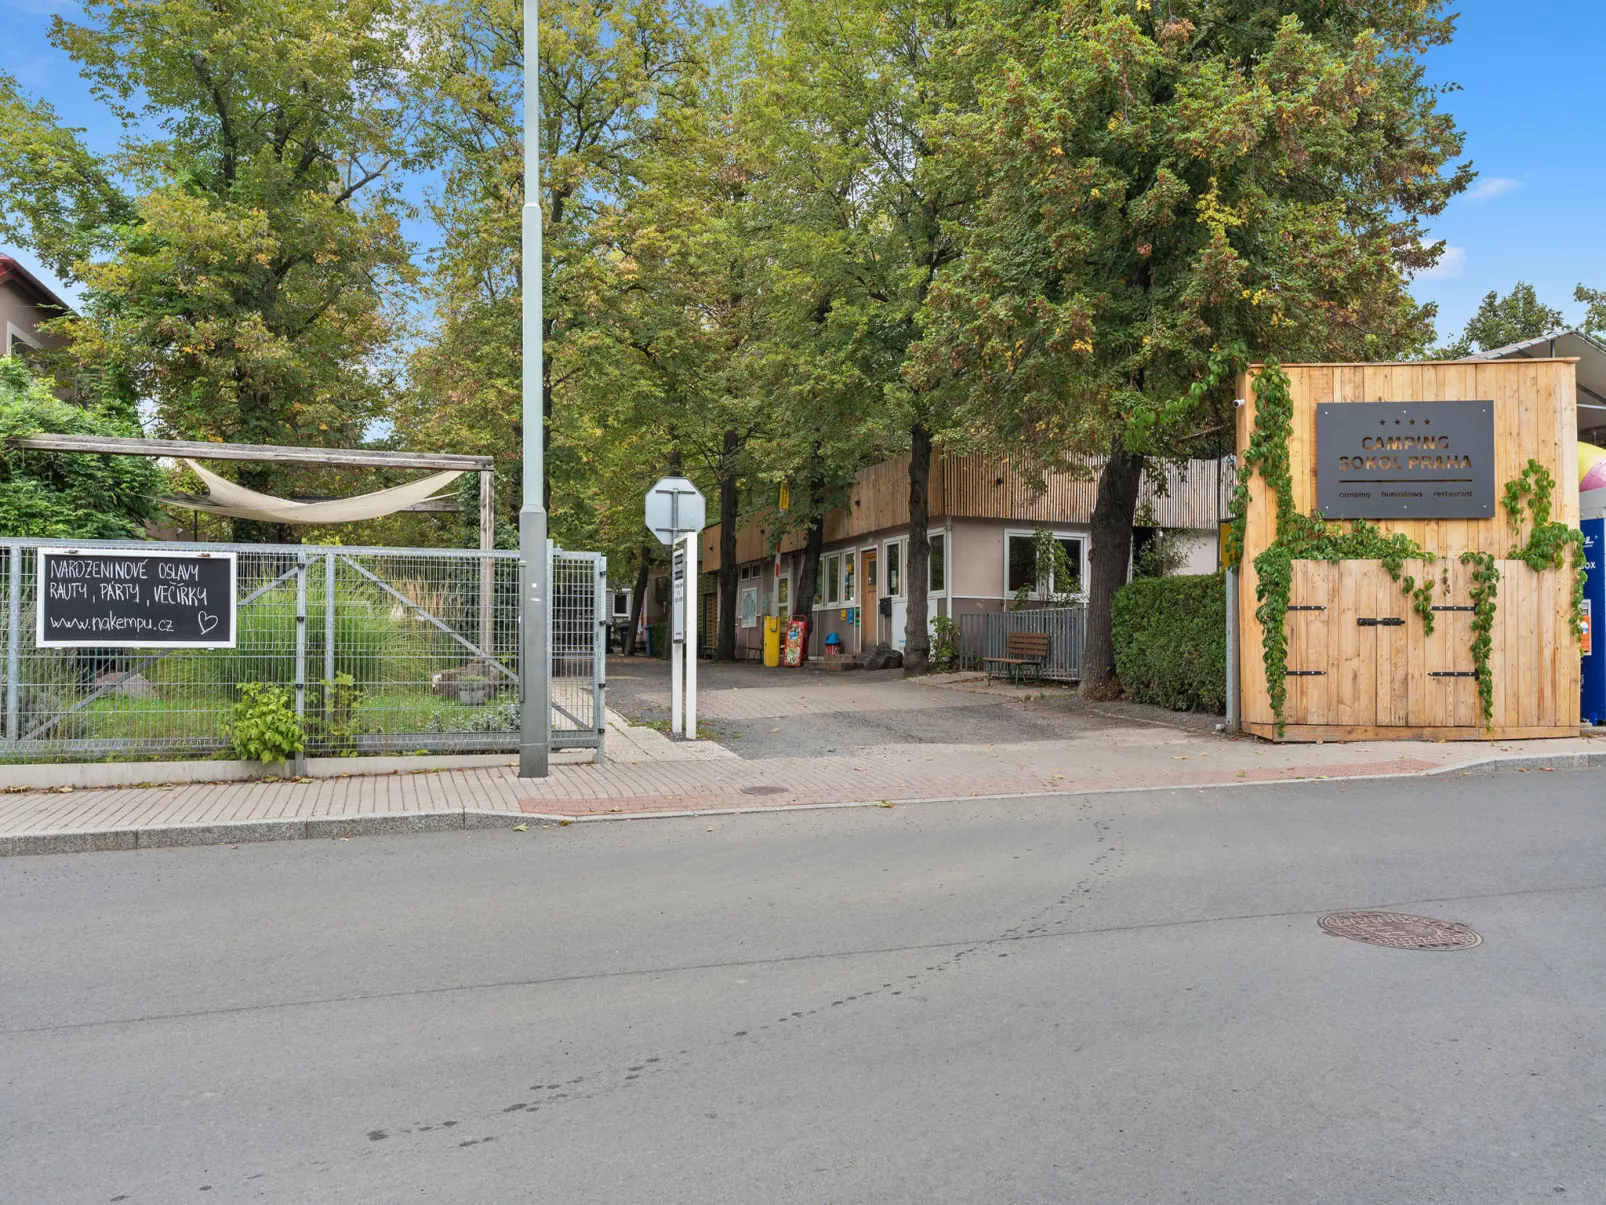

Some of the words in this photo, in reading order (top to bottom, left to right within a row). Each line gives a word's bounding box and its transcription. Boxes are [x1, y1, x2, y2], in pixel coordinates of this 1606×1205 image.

[1361, 435, 1450, 451] CAMPING
[1338, 455, 1403, 471] SOKOL
[1408, 454, 1473, 470] PRAHA
[1338, 490, 1371, 499] camping
[1381, 490, 1423, 499] bungalows
[1433, 490, 1473, 498] restaurant
[50, 558, 149, 579] NAROZENINOVÉ
[158, 562, 199, 581] OSLAVY
[50, 610, 175, 633] www.nakempu.cz
